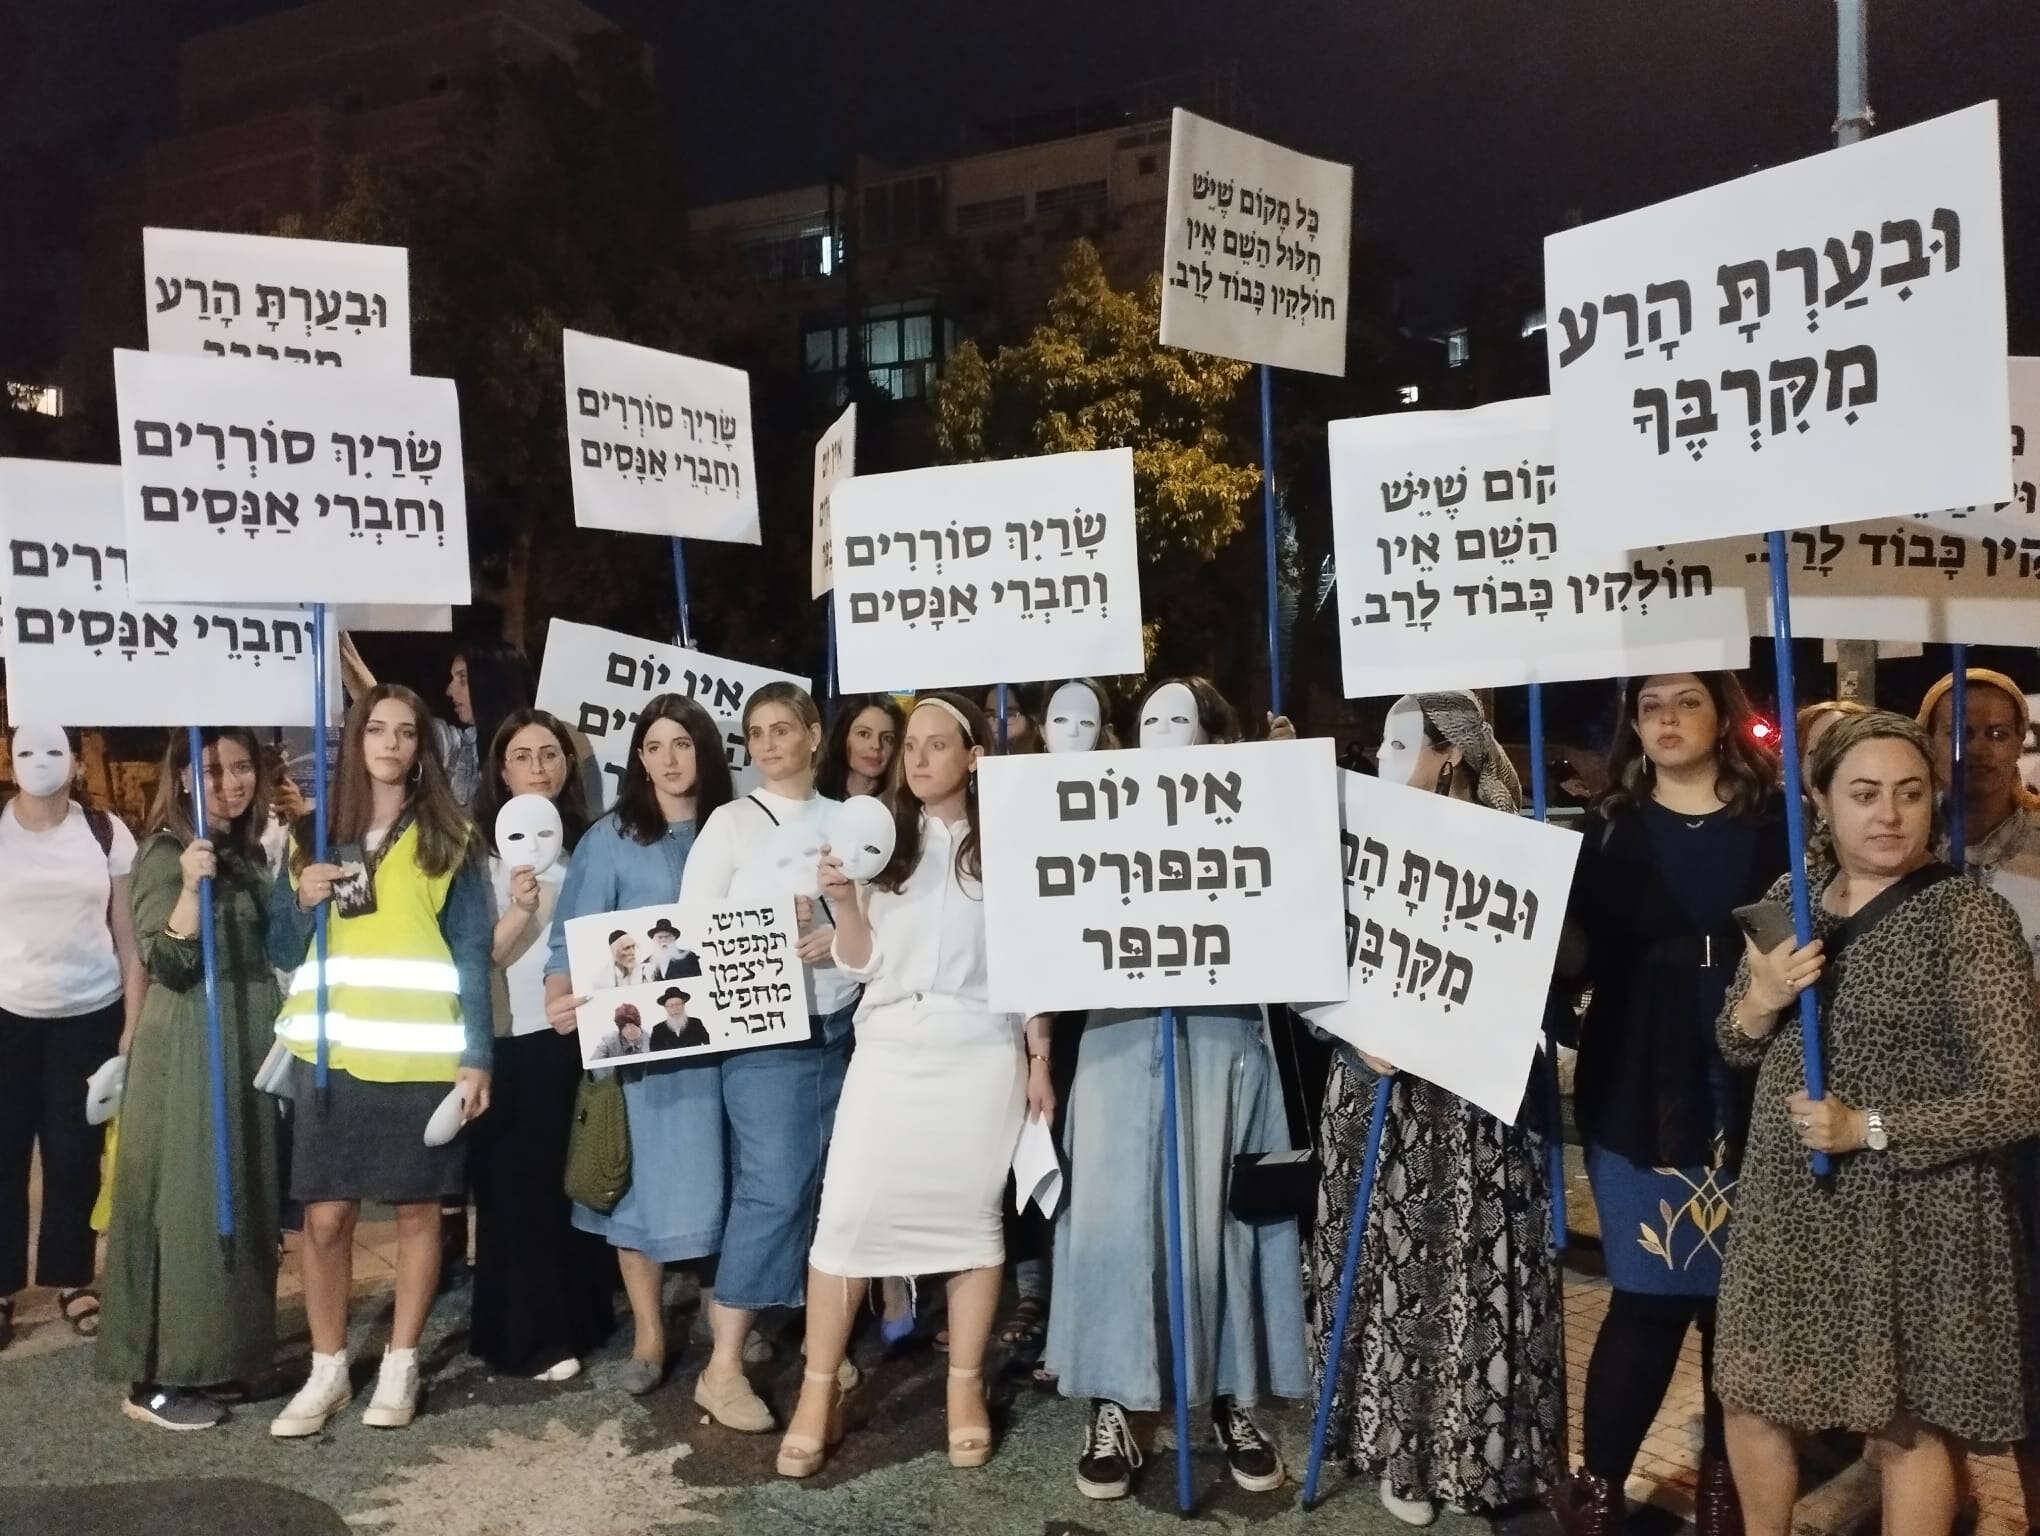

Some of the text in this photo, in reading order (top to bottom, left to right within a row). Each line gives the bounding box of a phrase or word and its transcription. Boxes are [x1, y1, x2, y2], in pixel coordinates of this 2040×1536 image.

[155, 276, 240, 328] הָרַע
[1557, 279, 1692, 368] הָרַע
[315, 493, 444, 547] וְחַבְרֵי
[1376, 532, 1440, 575] אֵין
[990, 572, 1109, 625] וְחַבְרֵי
[1453, 575, 1553, 622] כָּבוֹד
[606, 652, 671, 691] יוֹם
[1056, 768, 1242, 827] אֵין יוֹם
[702, 932, 787, 957] תתפטר
[1082, 923, 1231, 986] מְכַפֵּר
[709, 948, 784, 993] ליצמן
[708, 983, 792, 1011] מחפש
